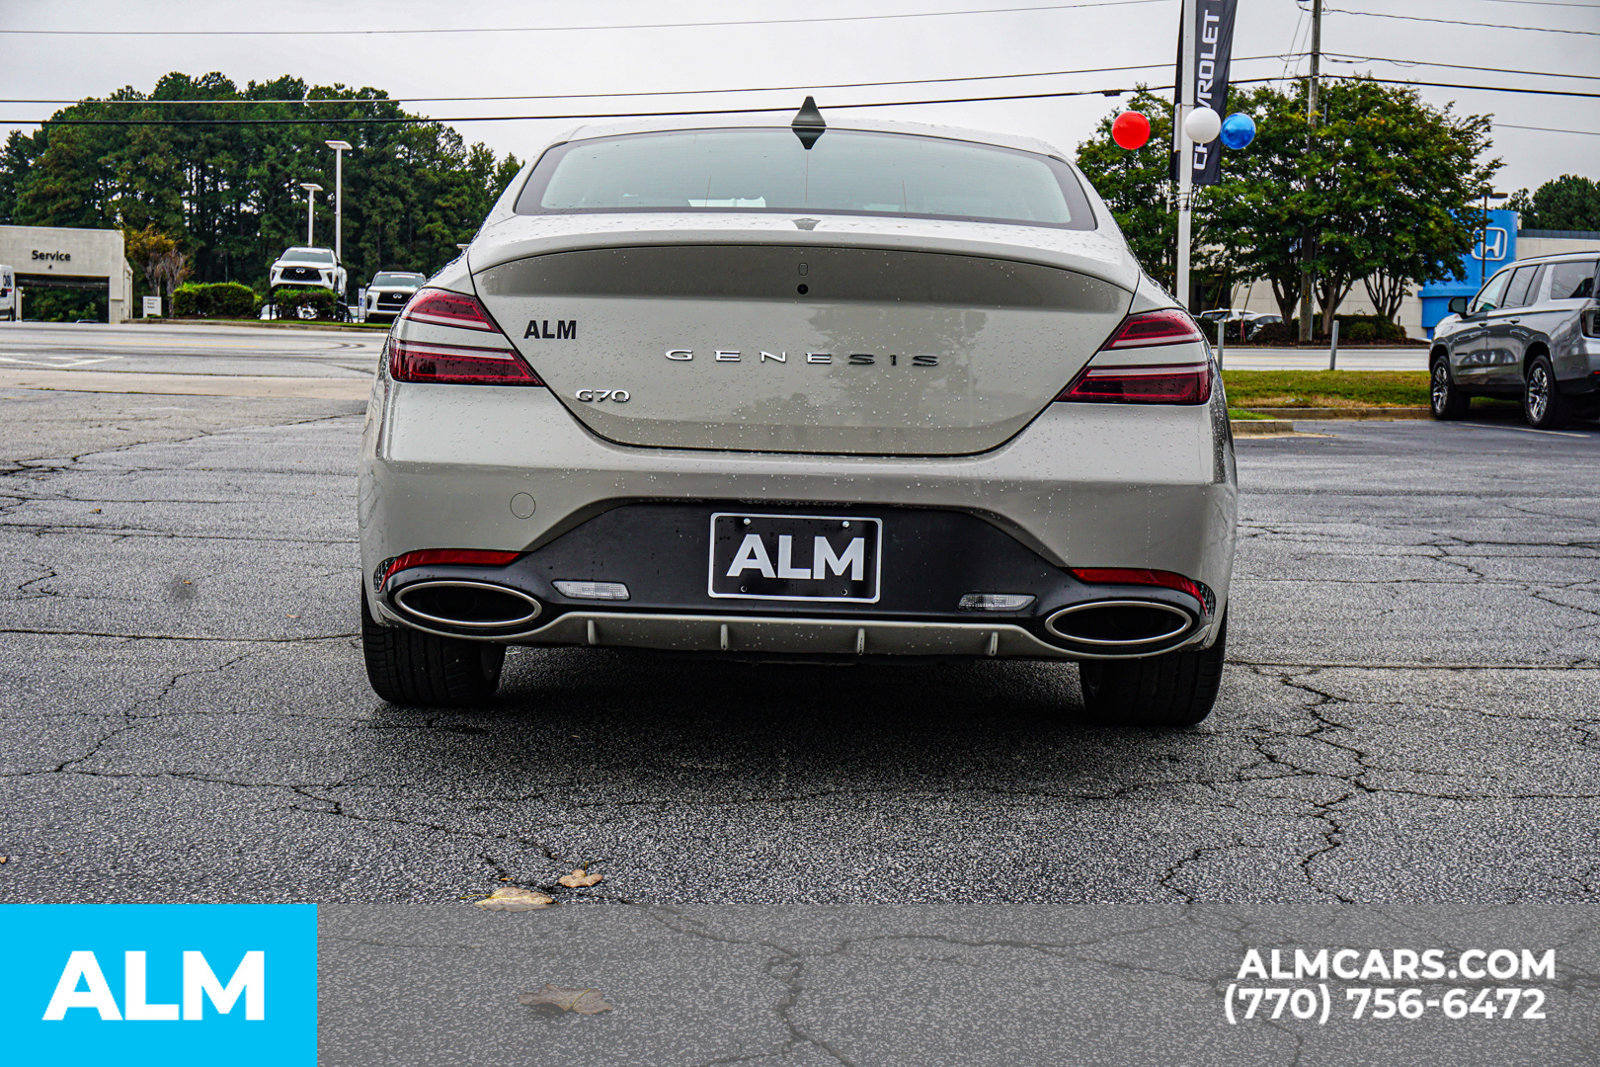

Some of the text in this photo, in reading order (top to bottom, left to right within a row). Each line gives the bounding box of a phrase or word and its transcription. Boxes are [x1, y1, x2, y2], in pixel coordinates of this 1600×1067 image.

[31, 249, 71, 261] Service
[523, 319, 577, 340] ALM
[665, 349, 939, 367] GENESIS
[575, 388, 631, 403] G70
[726, 533, 865, 581] ALM
